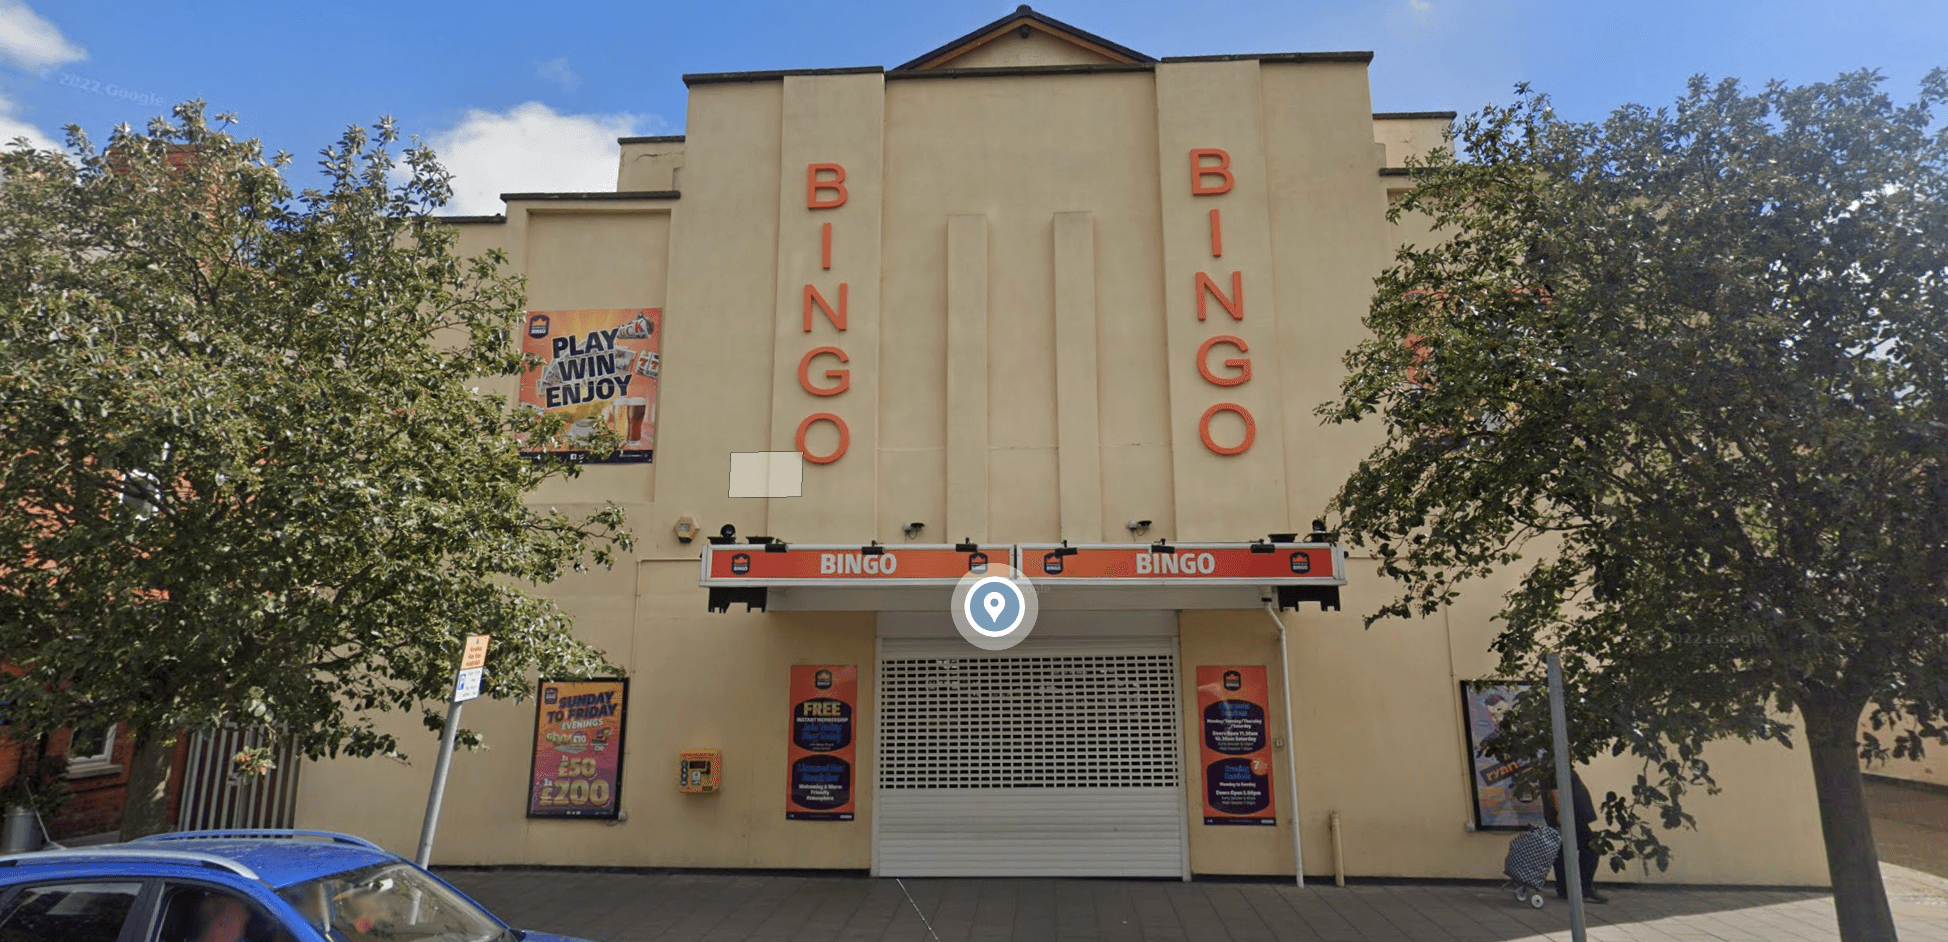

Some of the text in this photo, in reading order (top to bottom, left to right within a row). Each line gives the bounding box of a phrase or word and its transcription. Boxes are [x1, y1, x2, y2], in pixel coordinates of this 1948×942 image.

[796, 162, 851, 464] BINGO
[1190, 148, 1256, 456] BINGO
[552, 328, 619, 359] PLAY
[558, 353, 616, 382] WIN
[545, 374, 633, 408] ENJOY
[820, 553, 897, 575] BINGO
[1136, 552, 1216, 575] BINGO
[559, 691, 615, 709] SUNDAY
[803, 702, 842, 716] FREE
[547, 703, 618, 724] TO FRIDAY
[561, 718, 603, 730] EVENINGS
[557, 758, 597, 778] £50
[1253, 760, 1260, 770] 7
[539, 779, 609, 806] £200
